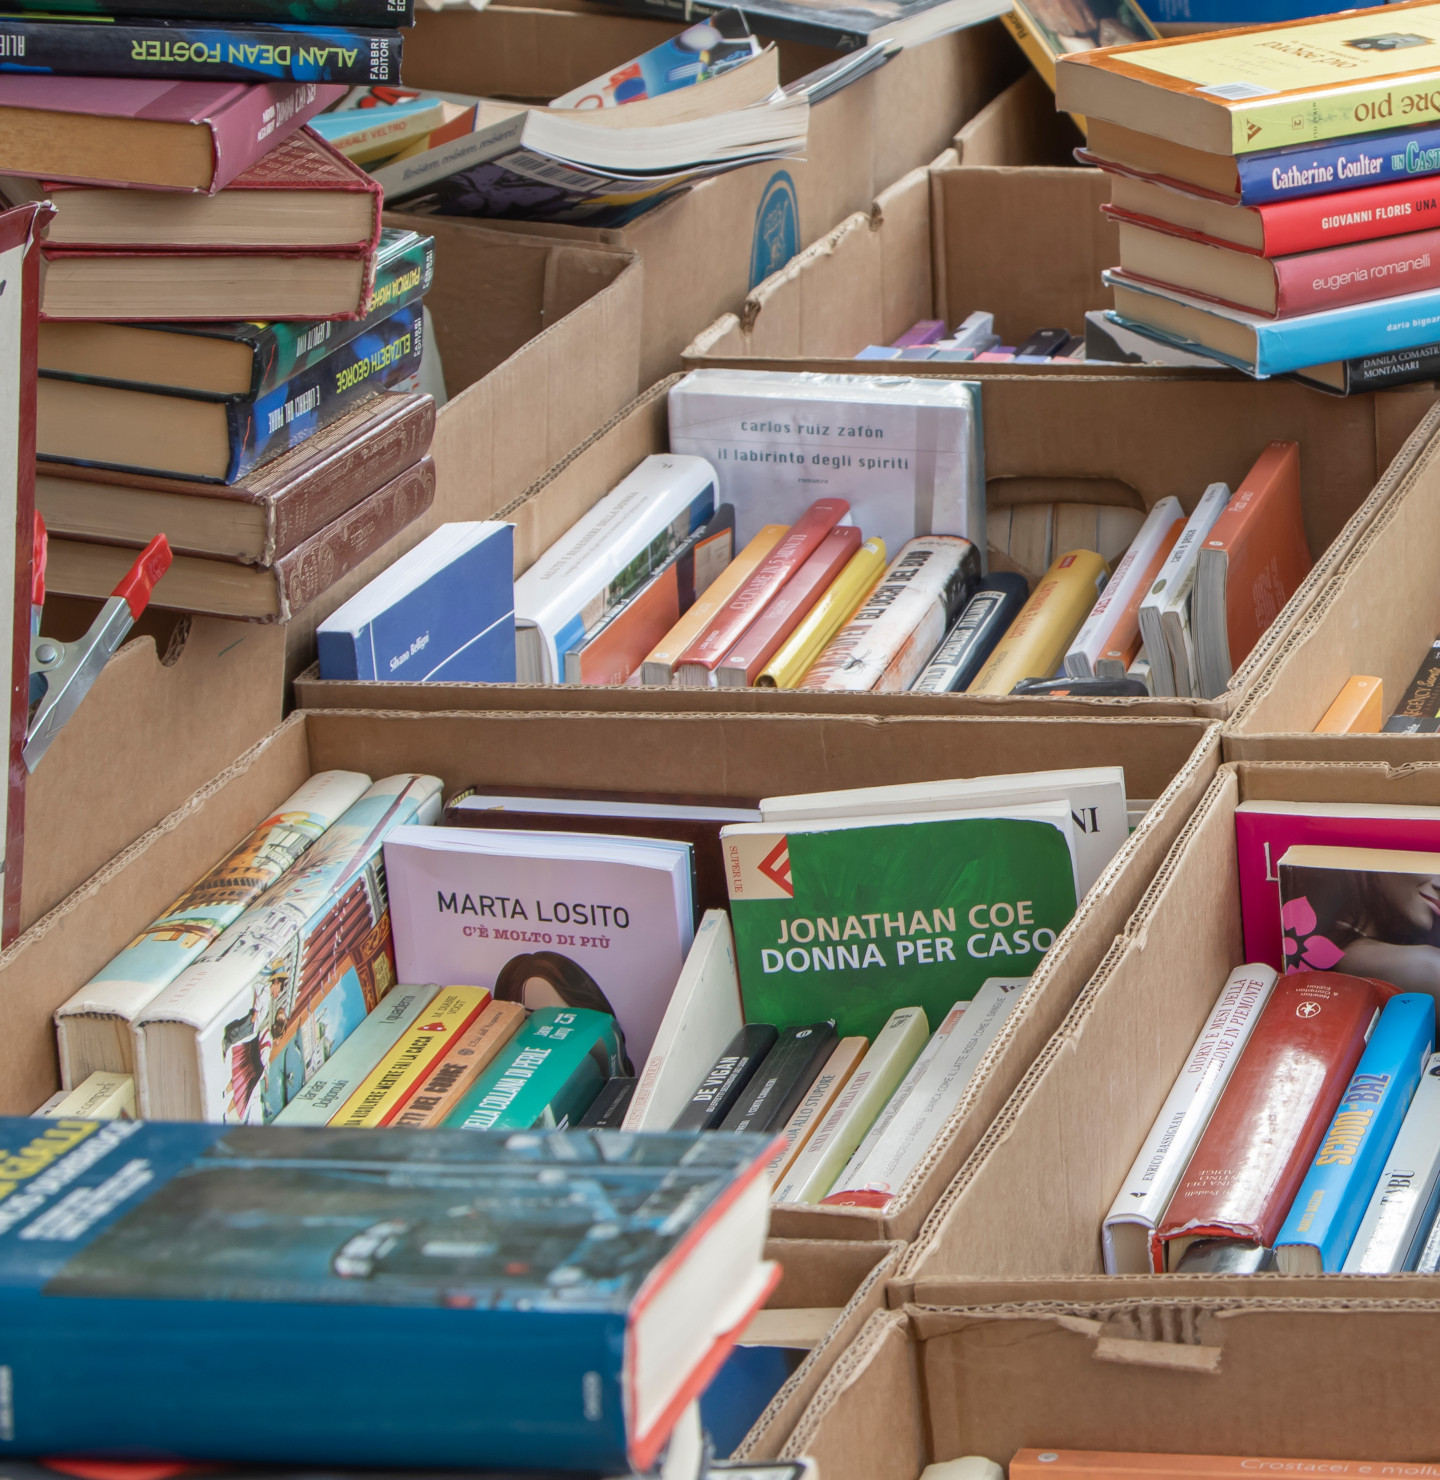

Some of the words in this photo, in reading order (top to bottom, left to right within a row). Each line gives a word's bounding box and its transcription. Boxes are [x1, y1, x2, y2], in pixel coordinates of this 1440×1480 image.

[132, 40, 220, 62] FOSTER
[229, 43, 291, 65] DEAN
[299, 47, 358, 67] ALAN
[370, 38, 379, 80] FABBRI
[380, 38, 389, 80] EDITORI
[371, 121, 407, 138] VELTRO
[1272, 162, 1334, 190] Catherine
[1337, 154, 1383, 180] Coulter
[1321, 210, 1372, 230] GIOVANNI
[1375, 203, 1412, 221] FLORIS
[1415, 198, 1437, 212] UNA
[392, 266, 421, 293] PATRICIA
[1312, 267, 1368, 290] eugenia
[1370, 253, 1430, 279] romanelli
[1386, 320, 1410, 332] daria
[371, 333, 411, 373] ELIZABETH
[1363, 354, 1396, 369] DANILA
[336, 358, 370, 394] GEORGE
[1363, 361, 1420, 379] MONTANARI
[740, 419, 791, 436] carlos
[797, 422, 831, 438] ruiz
[837, 423, 884, 439] zafón
[717, 448, 728, 462] il
[733, 448, 805, 466] labirinto
[811, 451, 853, 469] degli
[858, 454, 909, 471] spiriti
[437, 891, 528, 921] MARTA
[536, 900, 630, 929] LOSITO
[777, 908, 956, 944] JONATHAN
[968, 901, 1034, 928] COE
[493, 928, 552, 944] MOLTO
[557, 933, 576, 946] DI
[580, 933, 611, 949] PIÙ
[761, 944, 886, 973] DONNA
[897, 937, 954, 965] PER
[966, 928, 1057, 959] CASO
[1230, 976, 1264, 1027] PIEMONTE
[1295, 985, 1330, 997] Compton
[1300, 990, 1329, 1000] Newton
[387, 995, 416, 1022] quaderni
[448, 1000, 466, 1015] VOGT
[553, 1013, 577, 1023] 15
[1187, 1036, 1216, 1077] GIORNI
[1210, 1004, 1232, 1032] MESI
[1222, 974, 1246, 1008] DELLA
[1224, 1023, 1240, 1039] IN
[430, 1062, 468, 1095] CODICE
[710, 1057, 740, 1087] VIGAN
[794, 1105, 813, 1129] ALLO
[809, 1074, 836, 1108] STUPORE
[1343, 1074, 1391, 1105] BAZ
[1141, 1151, 1164, 1184] ENRICO
[1156, 1107, 1186, 1155] BASSIGNANA
[1315, 1109, 1375, 1166] SCHOOL
[1240, 1458, 1348, 1473] Crostacei
[1358, 1465, 1371, 1473] e
